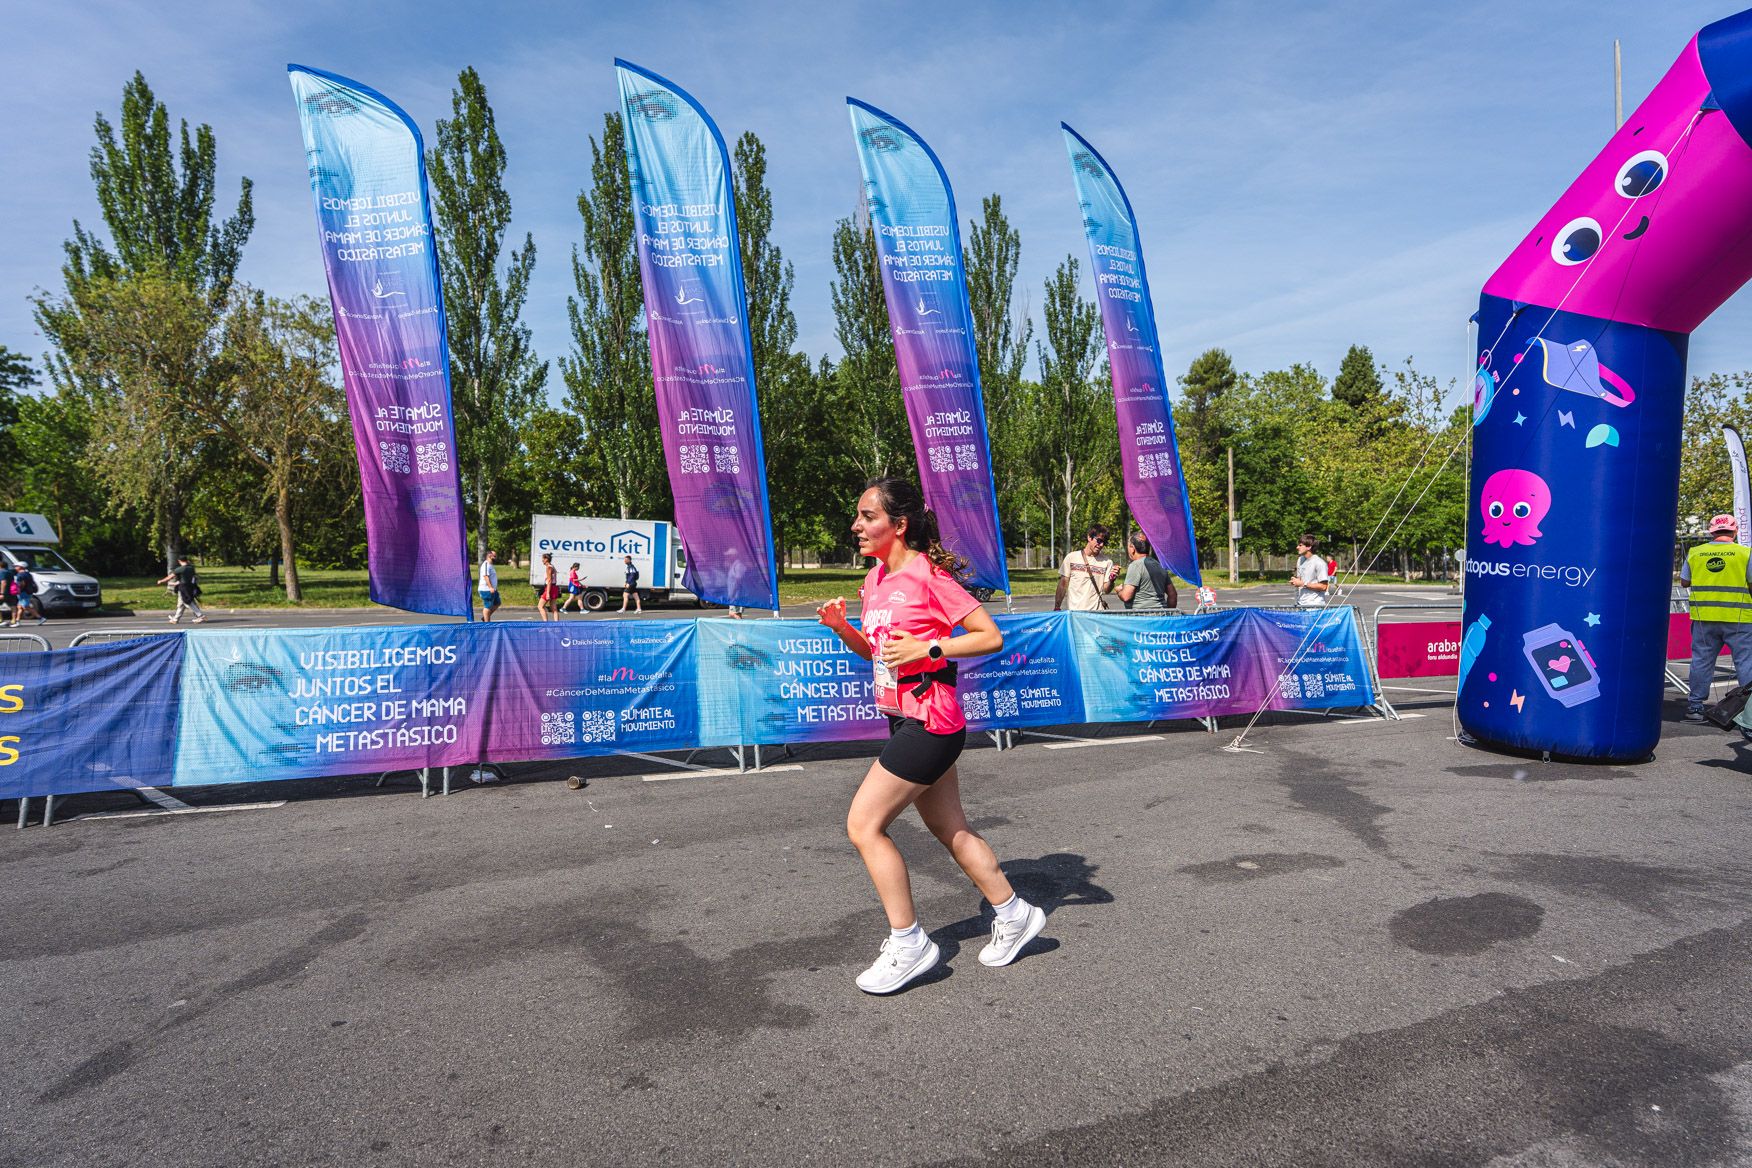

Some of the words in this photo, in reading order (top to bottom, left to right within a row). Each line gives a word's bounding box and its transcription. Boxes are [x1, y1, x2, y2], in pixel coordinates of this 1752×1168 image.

[539, 538, 606, 553] evento
[618, 539, 643, 554] kit
[1466, 558, 1510, 578] ctopus
[1512, 563, 1597, 587] energy
[1134, 628, 1220, 645] VISIBILICEMOS
[1427, 639, 1457, 652] araba
[300, 645, 457, 670] VISIBILICEMOS
[1132, 649, 1178, 662] JUNTOS
[1180, 648, 1196, 662] EL
[774, 660, 832, 675] JUNTOS
[837, 660, 855, 675] EL
[1139, 665, 1185, 683] CÁNCER
[1186, 666, 1202, 680] DE
[1202, 664, 1231, 679] MAMA
[288, 675, 371, 698] JUNTOS
[376, 674, 401, 694] EL
[781, 679, 839, 698] CÁNCER
[842, 682, 860, 698] DE
[1020, 686, 1050, 699] SÚMATE
[1154, 682, 1230, 703] METASTÁSICO
[295, 701, 376, 725] CÁNCER
[381, 701, 406, 721] DE
[411, 697, 466, 719] MAMA
[1021, 698, 1061, 709] MOVIMIENTO
[621, 706, 662, 721] SÚMATE
[664, 709, 674, 718] AL
[621, 720, 675, 732] MOVIMIENTO
[316, 723, 457, 753] METASTÁSICO
